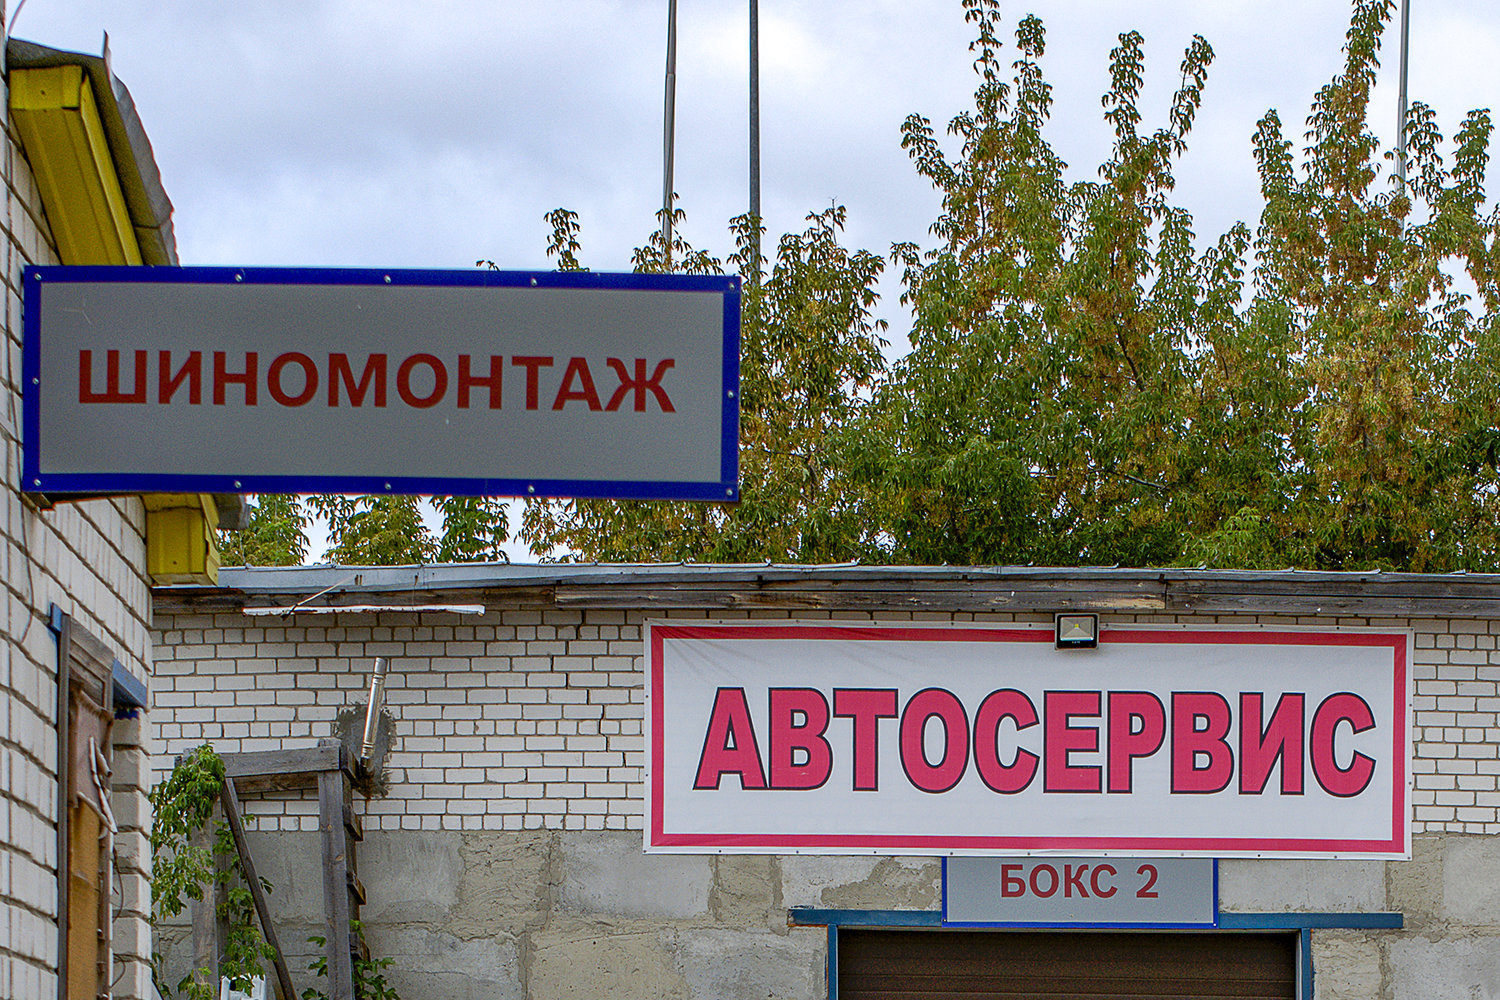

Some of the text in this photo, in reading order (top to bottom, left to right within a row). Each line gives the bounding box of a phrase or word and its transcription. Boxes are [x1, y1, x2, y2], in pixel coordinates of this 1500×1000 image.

[78, 350, 676, 413] ШИНОМОНТАЖ
[692, 686, 1377, 798] АВТОСЕРВИС
[1000, 863, 1158, 900] БОКС 2
